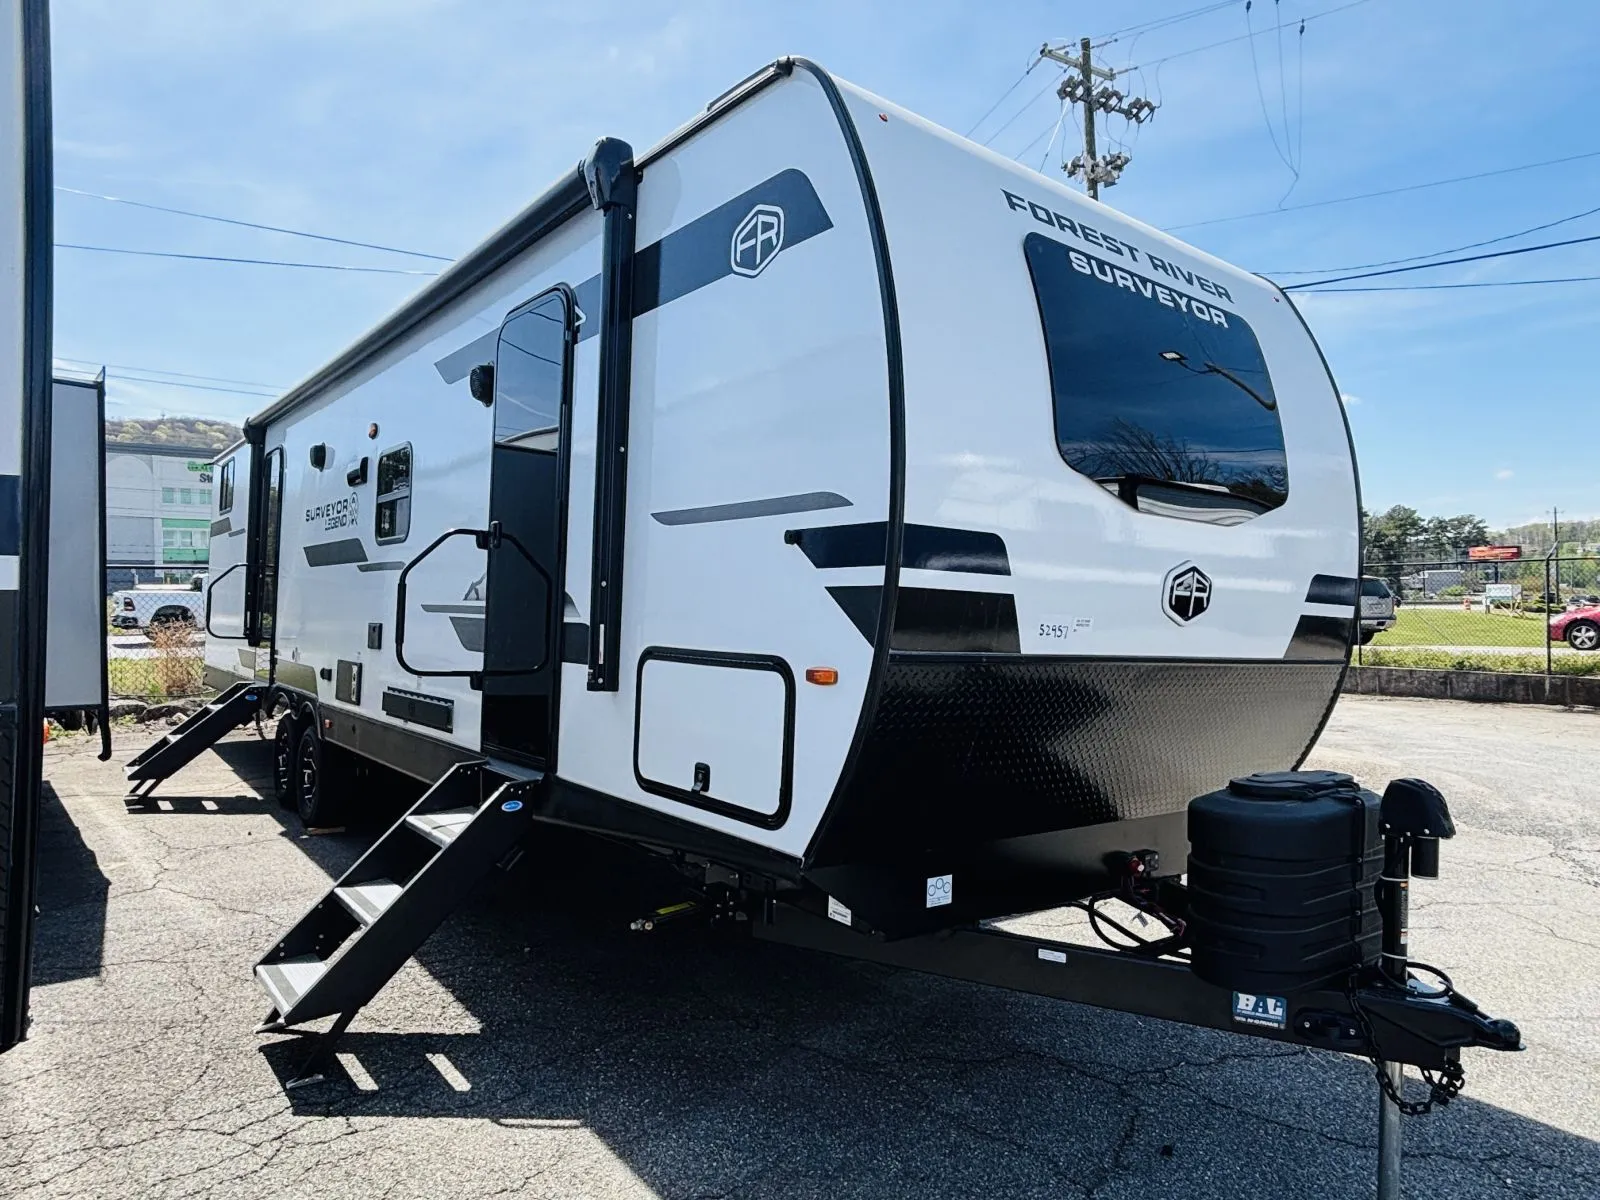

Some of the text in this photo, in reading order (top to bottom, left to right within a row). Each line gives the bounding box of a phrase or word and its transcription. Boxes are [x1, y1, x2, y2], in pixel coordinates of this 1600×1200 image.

[1001, 188, 1235, 304] FOREST RIVER
[1068, 251, 1229, 328] SURVEYOR
[305, 498, 349, 522] SURVEYOR
[324, 514, 348, 531] LEGEND
[1038, 623, 1069, 639] 52957
